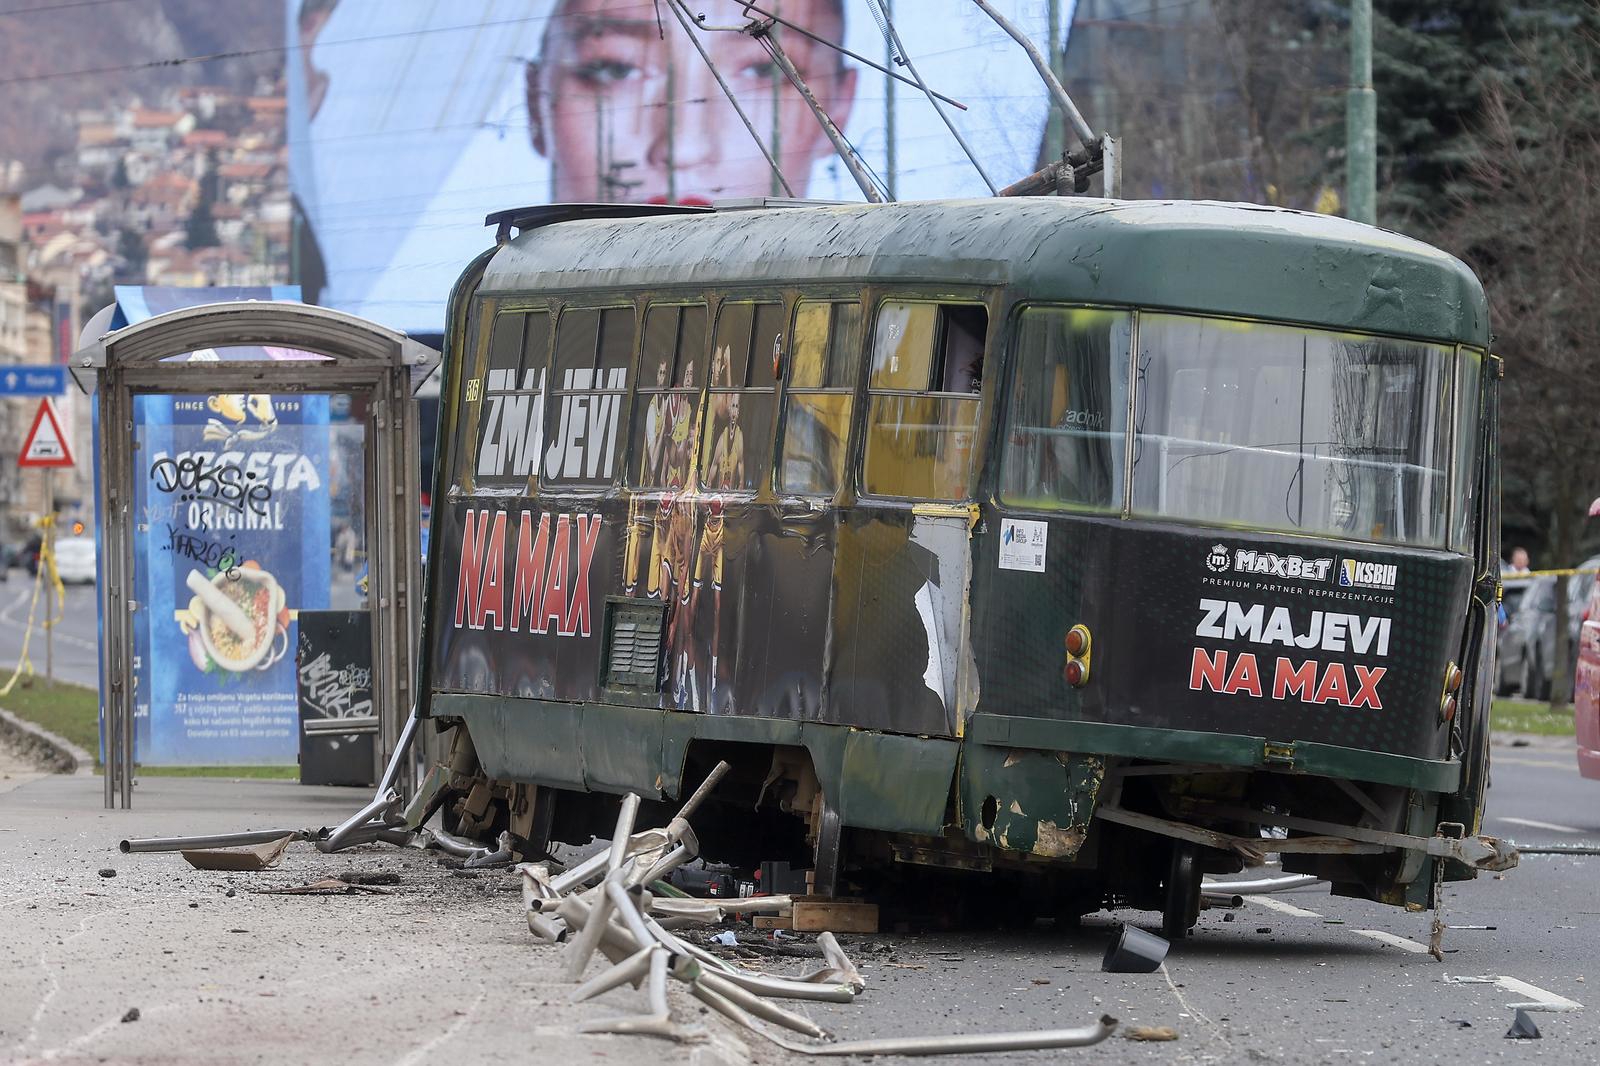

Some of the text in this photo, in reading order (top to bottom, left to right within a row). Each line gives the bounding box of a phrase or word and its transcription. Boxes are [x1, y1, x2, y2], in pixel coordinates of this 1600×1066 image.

[175, 401, 300, 411] SINCE 1959
[478, 367, 627, 479] ZMAJEVI
[153, 451, 320, 491] VEGETA
[189, 501, 284, 531] ORIGINAL
[455, 509, 602, 637] NA MAX
[1202, 577, 1395, 604] PREMIUM PARTNER REPREZENTACIJE
[1355, 561, 1398, 585] KSBIH
[1195, 598, 1392, 657] ZMAJEVI
[1189, 647, 1388, 710] NA MAX
